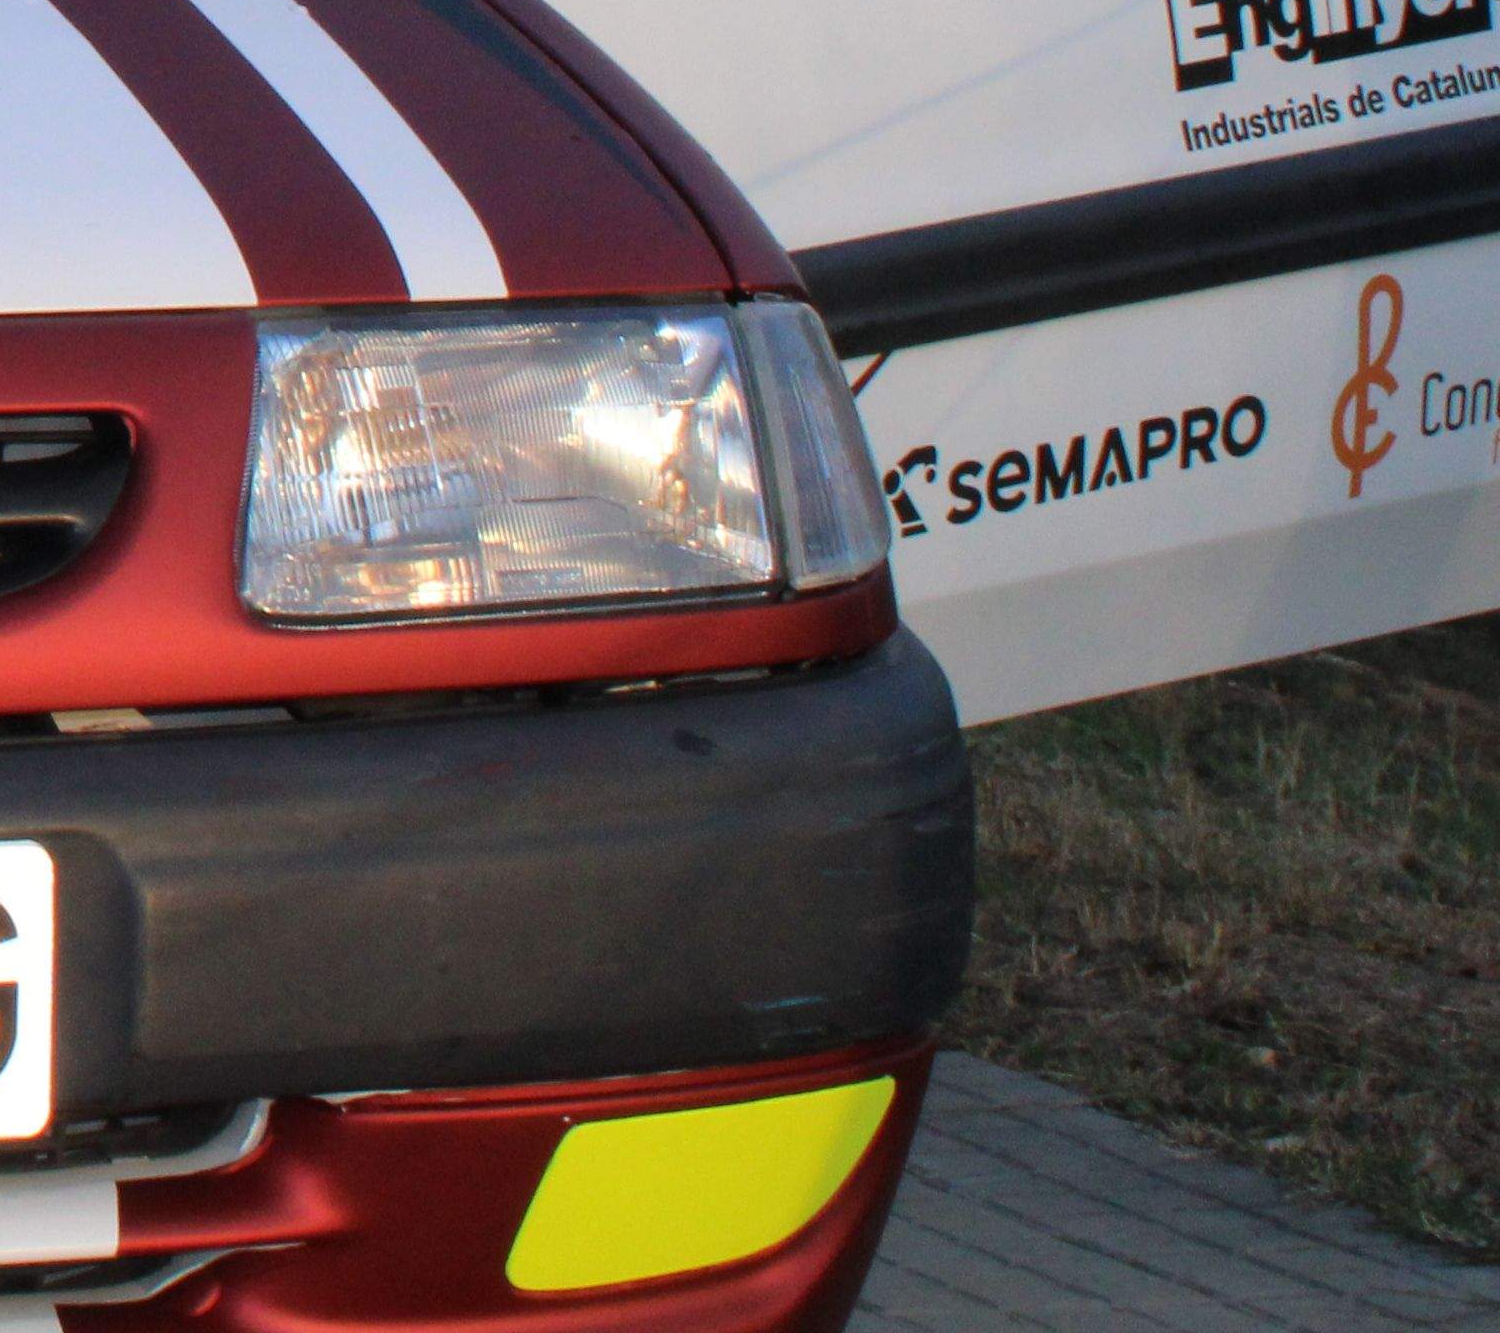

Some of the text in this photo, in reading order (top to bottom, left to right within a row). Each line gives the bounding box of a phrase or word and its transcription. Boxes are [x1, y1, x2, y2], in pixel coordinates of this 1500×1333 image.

[1181, 92, 1341, 152] Industrials
[1348, 82, 1384, 118] de
[1421, 370, 1500, 437] Con
